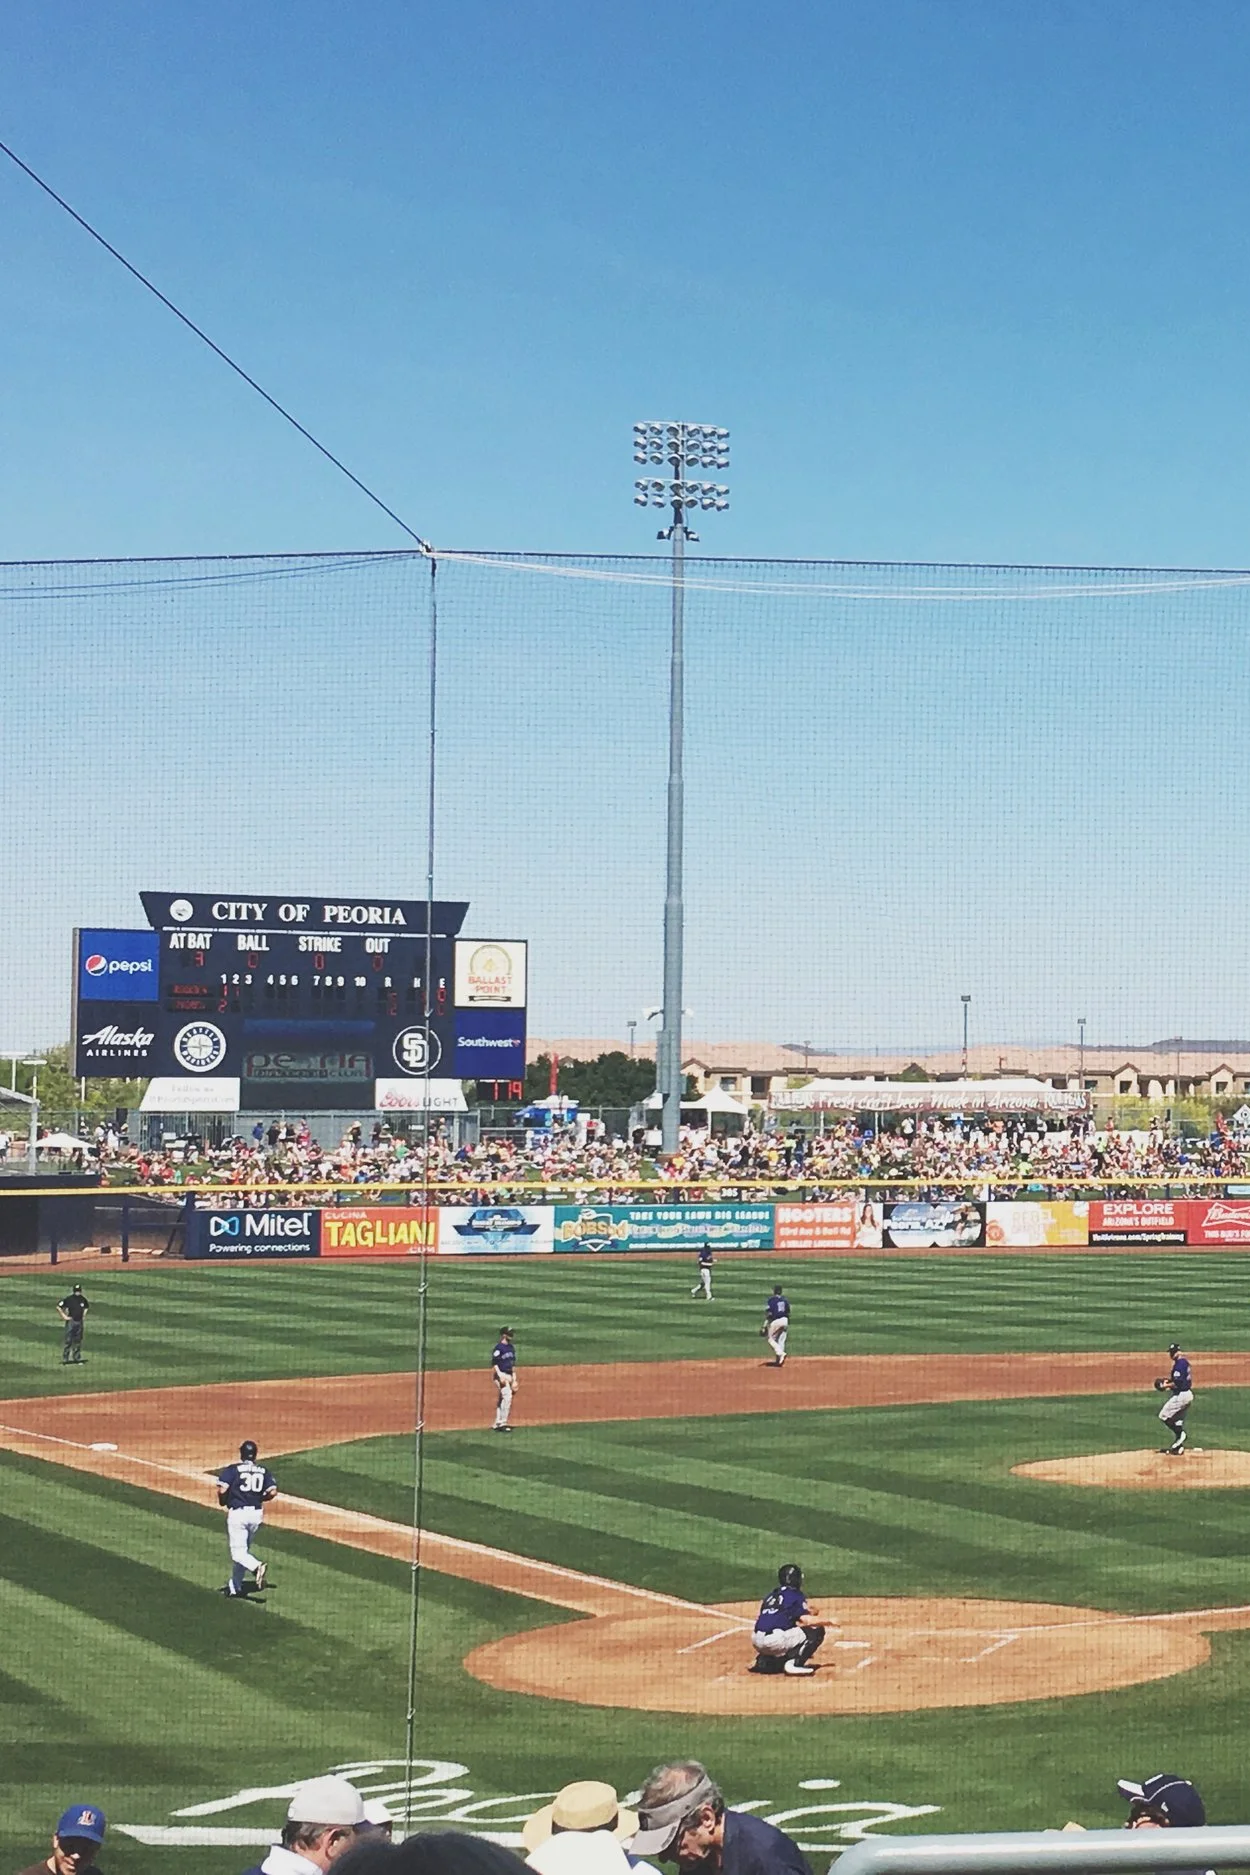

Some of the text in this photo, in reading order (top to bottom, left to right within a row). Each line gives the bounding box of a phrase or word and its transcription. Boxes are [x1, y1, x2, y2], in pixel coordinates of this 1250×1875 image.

[211, 902, 407, 925] CITY OF PEORIA
[169, 933, 212, 950] AT BAT
[237, 934, 270, 951] BALL
[299, 936, 342, 953] STRIKE
[365, 938, 391, 954] OUT
[109, 959, 153, 975] pepsi
[468, 976, 512, 984] BALLAST
[82, 1025, 155, 1048] Alaska
[457, 1037, 513, 1048] Southwest
[86, 1049, 148, 1057] AIRLINES
[379, 1092, 420, 1108] Coors
[931, 1091, 967, 1109] Made
[972, 1093, 986, 1108] in
[778, 1207, 853, 1223] HOOTERS
[1103, 1203, 1175, 1215] EXPLORE
[245, 1213, 311, 1237] Mitel
[324, 1219, 436, 1248] TAGLIANI
[209, 1242, 310, 1254] Powering connections
[240, 1472, 264, 1492] 30
